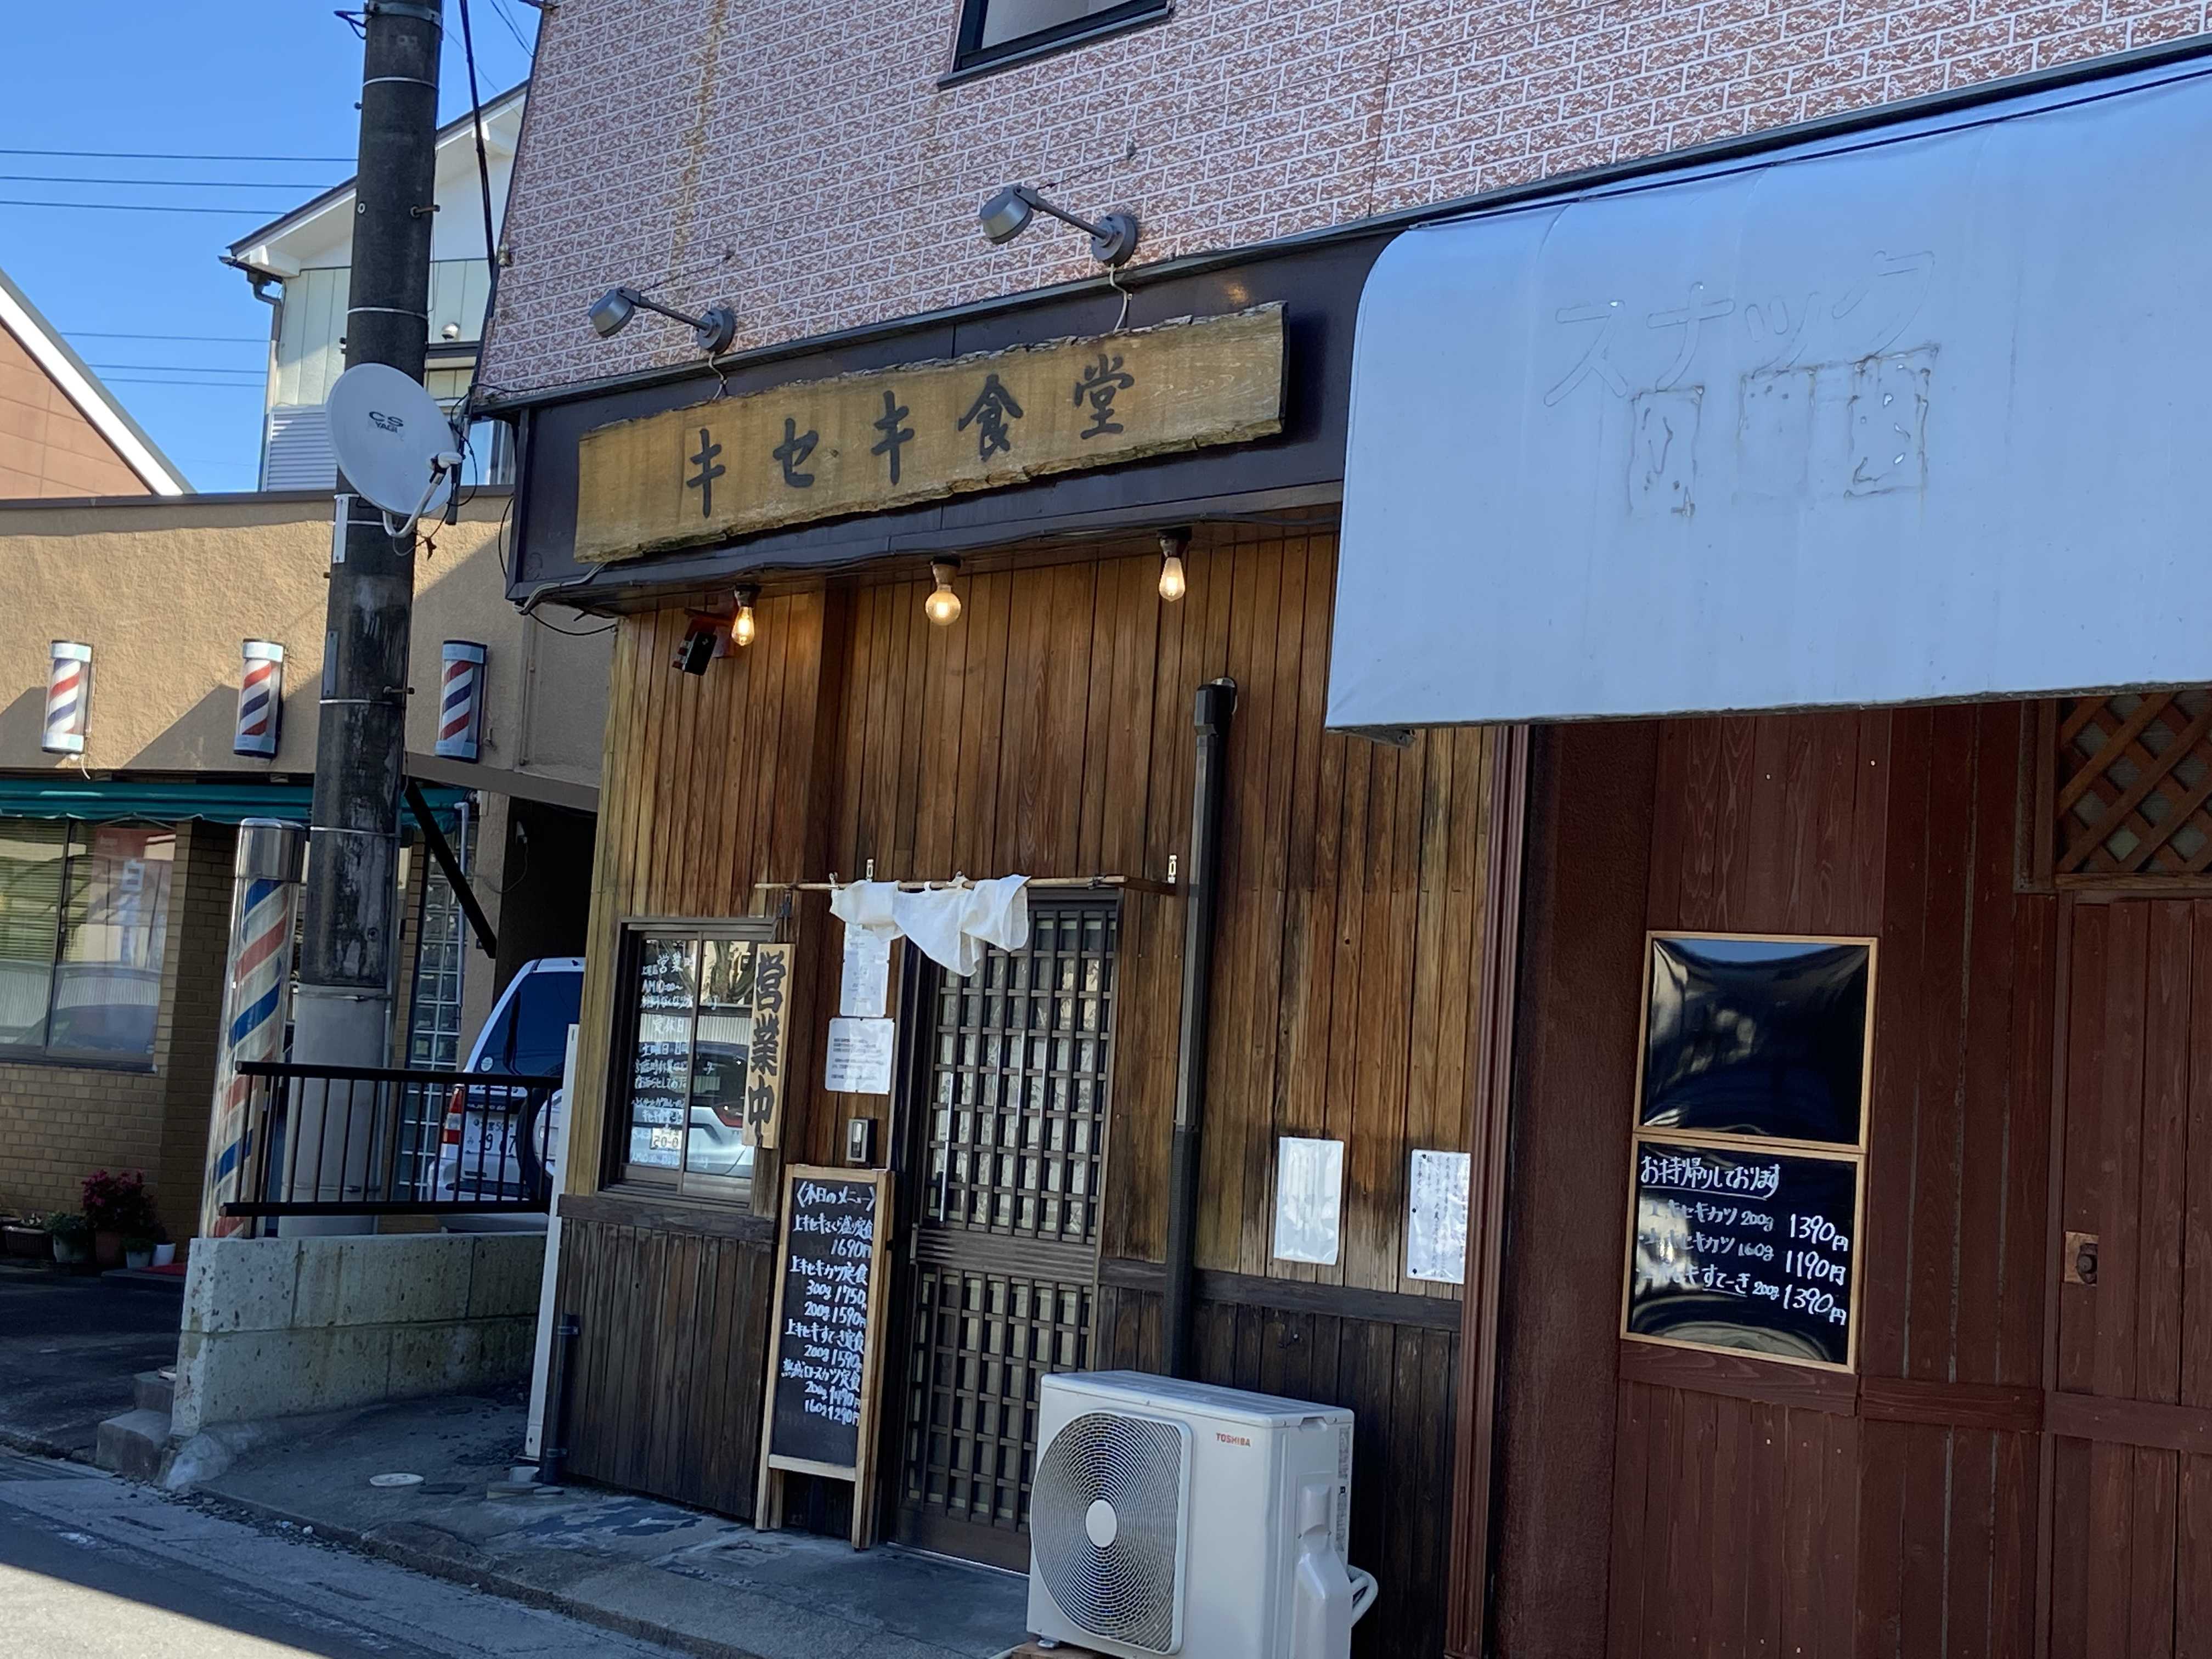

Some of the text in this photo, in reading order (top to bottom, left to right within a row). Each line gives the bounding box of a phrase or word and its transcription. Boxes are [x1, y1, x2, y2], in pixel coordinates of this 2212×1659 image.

[369, 411, 403, 427] CS
[685, 354, 1135, 518] キセキ食堂
[748, 950, 786, 1148] 営業中
[1640, 1155, 1781, 1198] お持帰りしております
[1740, 1210, 1774, 1232] 200g
[1790, 1214, 1848, 1251] 1390円
[831, 1238, 872, 1259] 1690円
[1738, 1243, 1774, 1261] 160g
[1786, 1250, 1846, 1286] 1190円
[806, 1279, 867, 1310] 300g 1750円
[1752, 1281, 1780, 1300] 200g
[1784, 1284, 1847, 1325] 1390円
[804, 1301, 867, 1328] 200g 1590円
[804, 1345, 830, 1362] 200g
[804, 1381, 827, 1401] 200g
[805, 1399, 860, 1426] 160g 1290円
[1216, 1432, 1251, 1447] TOSHIBA
